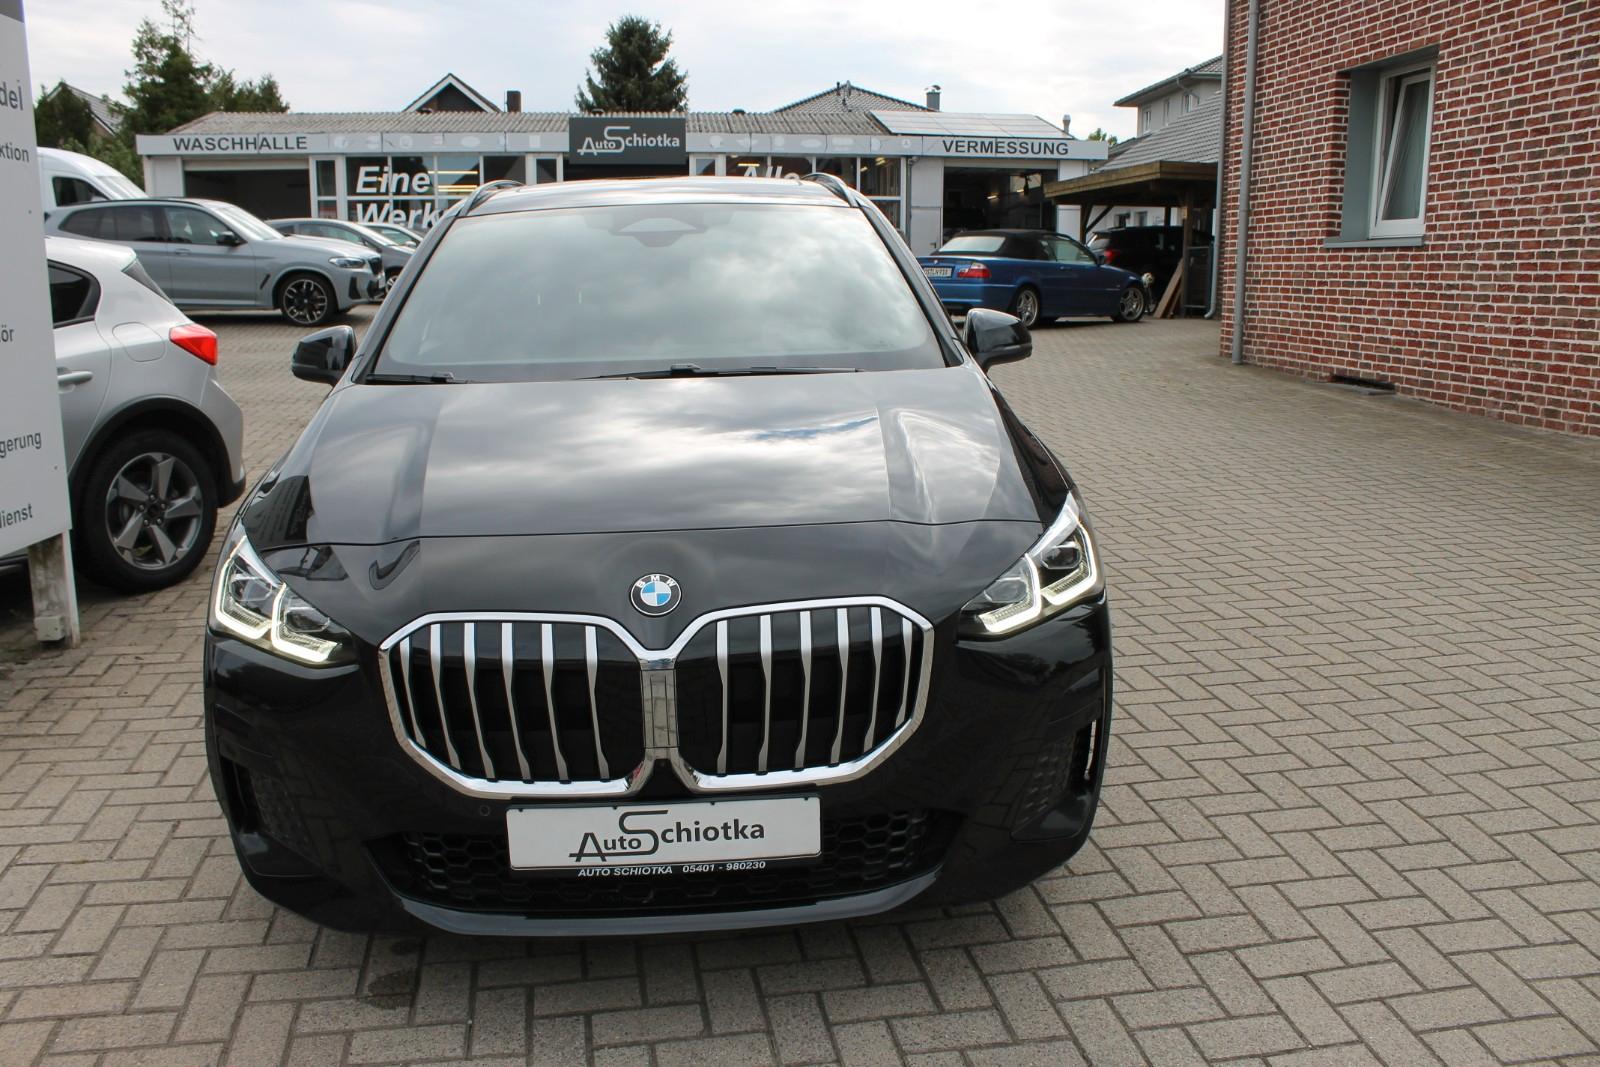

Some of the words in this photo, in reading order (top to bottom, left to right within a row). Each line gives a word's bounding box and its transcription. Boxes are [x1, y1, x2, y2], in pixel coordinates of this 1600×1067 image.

[173, 136, 308, 151] WASCHHALLE
[942, 139, 1069, 156] VERMESSUNG
[356, 166, 430, 193] Eine
[356, 203, 443, 229] Werk
[0, 503, 33, 528] ienst
[635, 574, 677, 588] BMW
[577, 867, 611, 877] AUTO
[613, 865, 673, 876] SCHIOTKA
[682, 863, 715, 873] 05401
[725, 861, 767, 871] 980230
